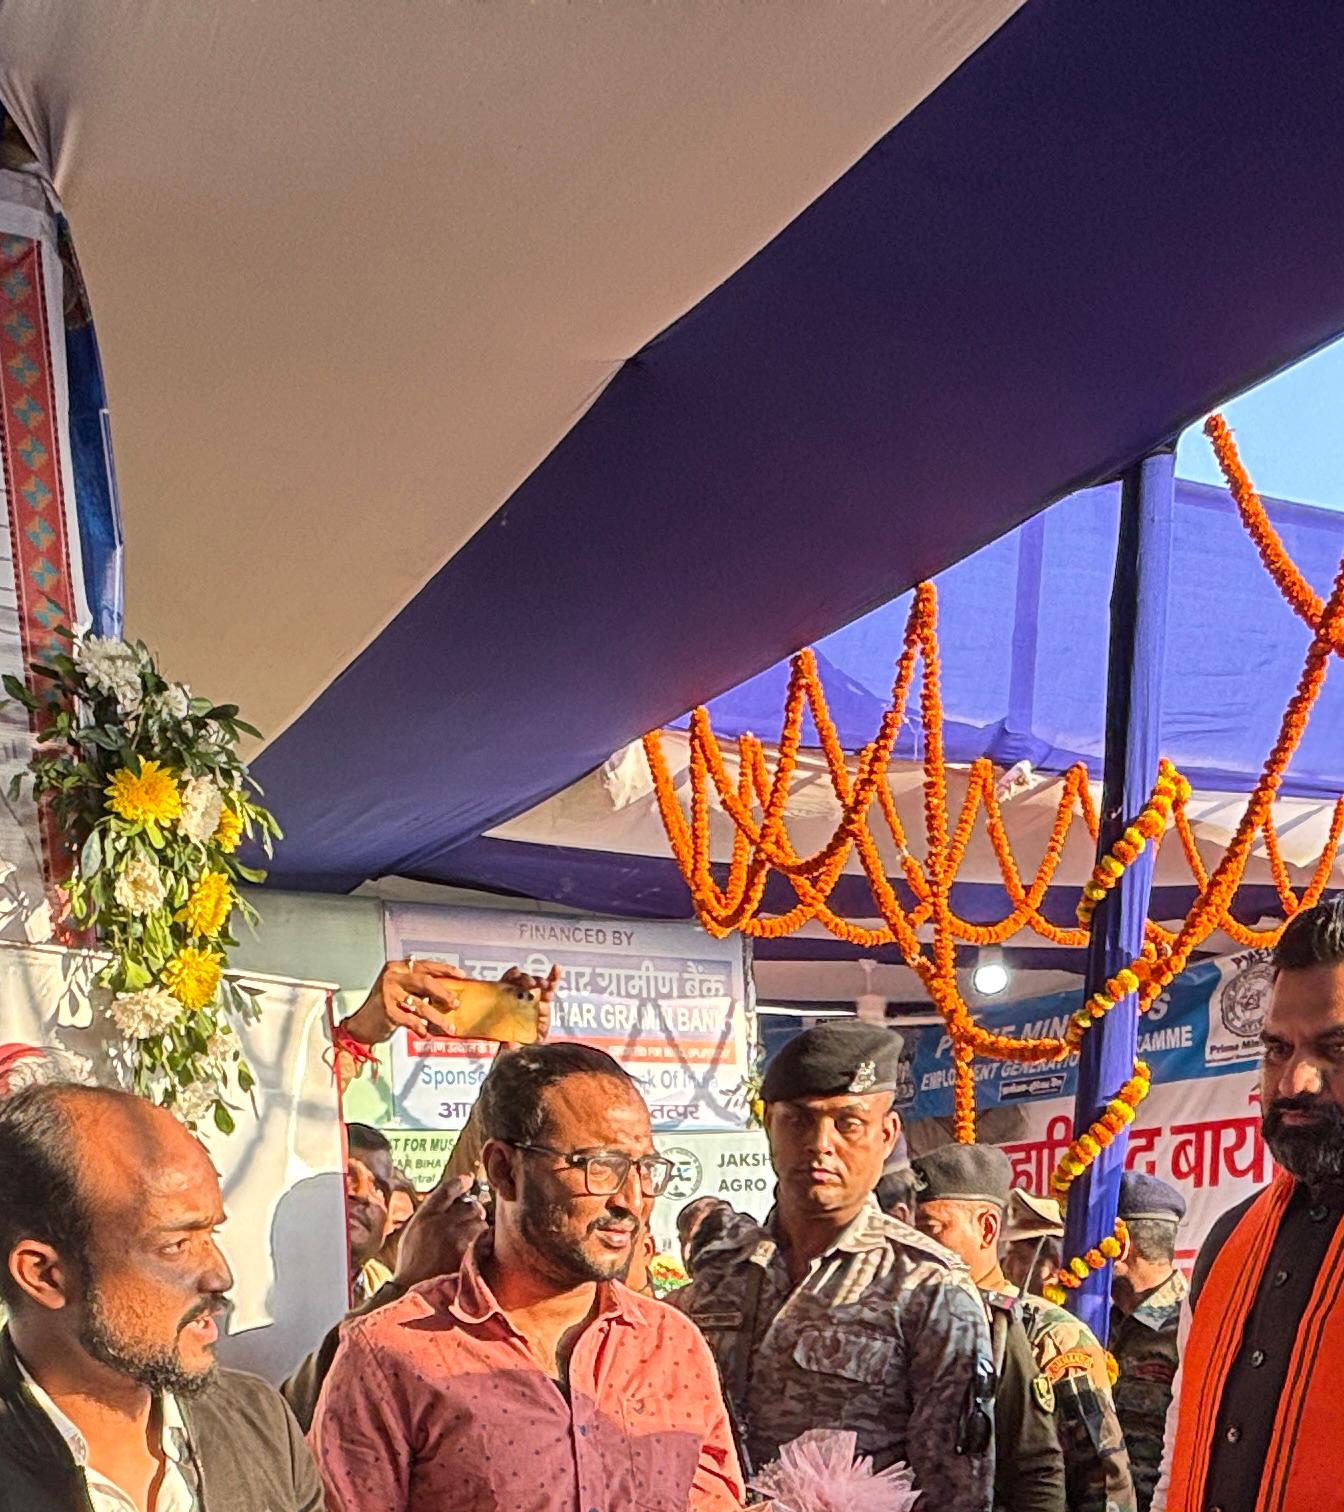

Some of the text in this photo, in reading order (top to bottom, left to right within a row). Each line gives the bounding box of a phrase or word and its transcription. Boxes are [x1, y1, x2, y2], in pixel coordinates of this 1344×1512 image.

[519, 923, 635, 947] FINANCED BY
[660, 1070, 678, 1089] Of
[403, 1138, 427, 1152] FOR
[718, 1177, 768, 1193] AGRO
